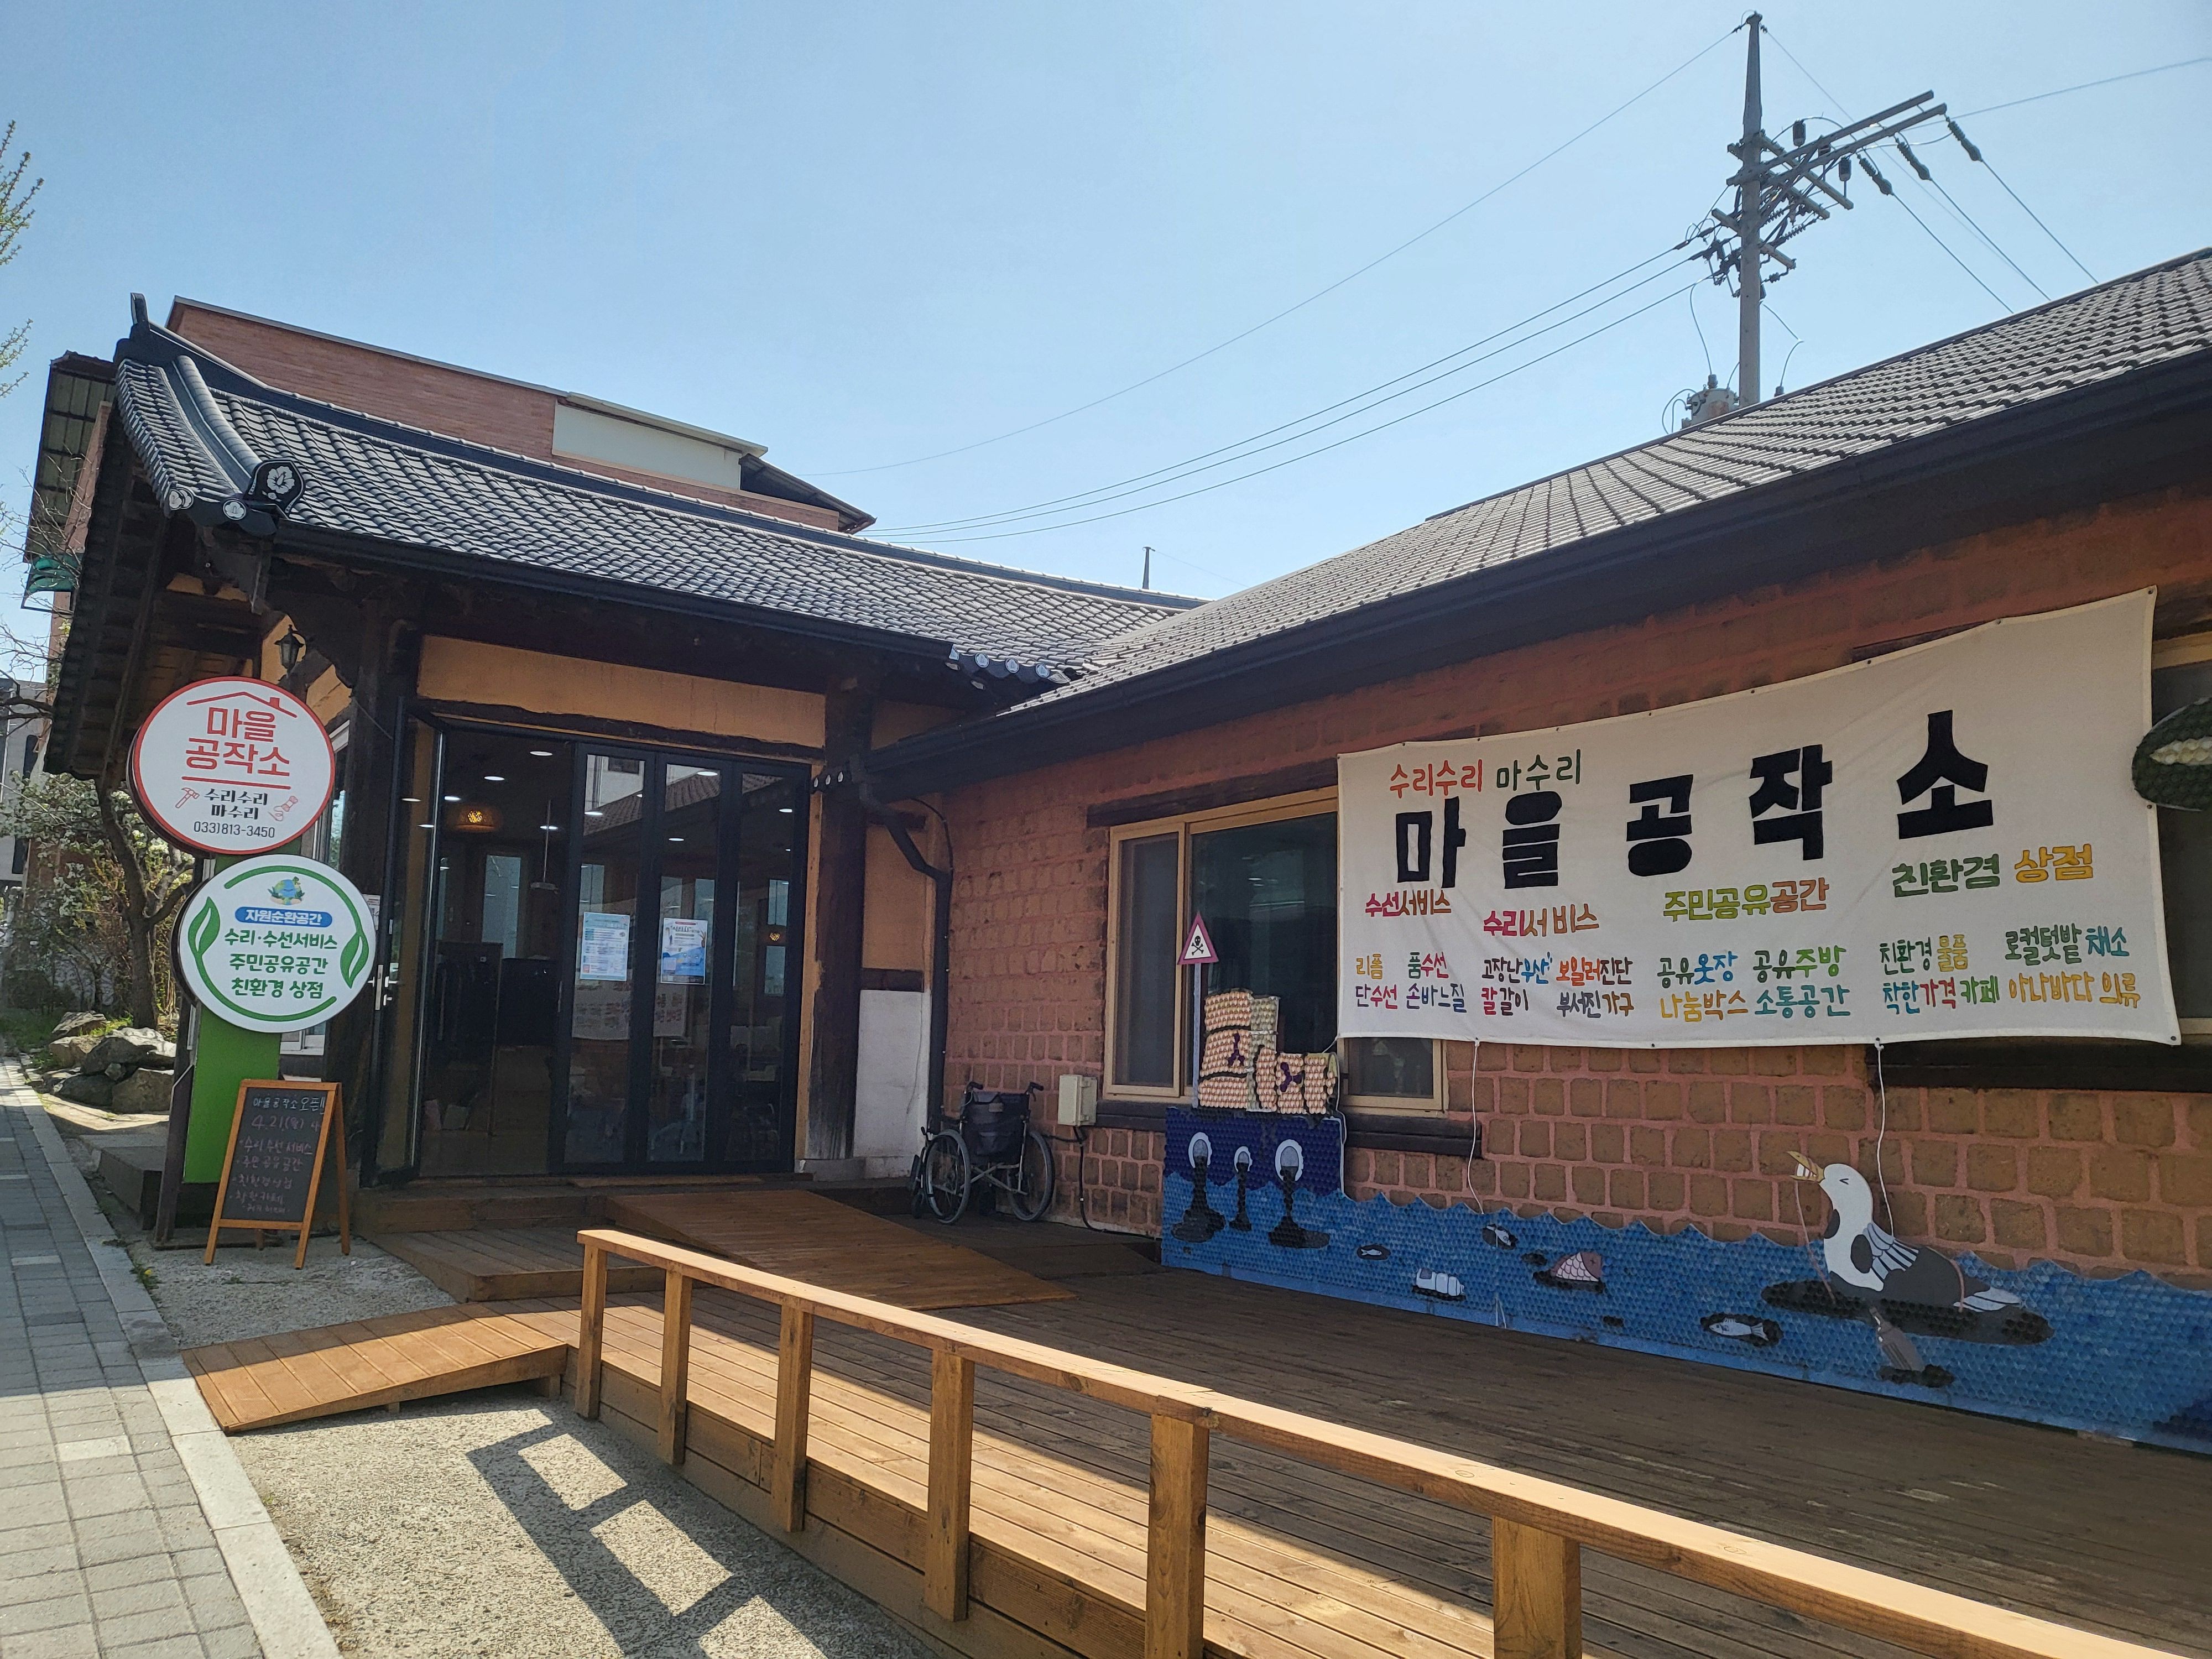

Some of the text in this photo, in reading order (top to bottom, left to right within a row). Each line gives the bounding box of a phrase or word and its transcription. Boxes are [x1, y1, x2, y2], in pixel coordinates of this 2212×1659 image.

[207, 707, 276, 742] 마을
[186, 738, 290, 776] 공작소
[1390, 749, 1580, 798] 수리수리 마수리
[204, 789, 268, 806] 수리수리
[211, 805, 259, 820] 마수리
[194, 821, 275, 838] 033)813-3450
[1892, 844, 2093, 898] 친환경 상점
[1365, 889, 1452, 917] 수선서비스
[1663, 878, 1829, 922] 주민공유공간
[245, 909, 322, 925] 자원순환공간
[1484, 904, 1599, 936] 수리서비스
[229, 954, 328, 974] 주민공유공간
[1357, 951, 1449, 979] 리폼 품수선
[232, 978, 323, 999] 친환경 상점
[1355, 983, 1467, 1013] 단수선 손바느질
[2009, 971, 2094, 1002] 아나바다
[1481, 987, 1528, 1016] 칼갈이
[1661, 984, 1850, 1022] 나눔박스 소통공간
